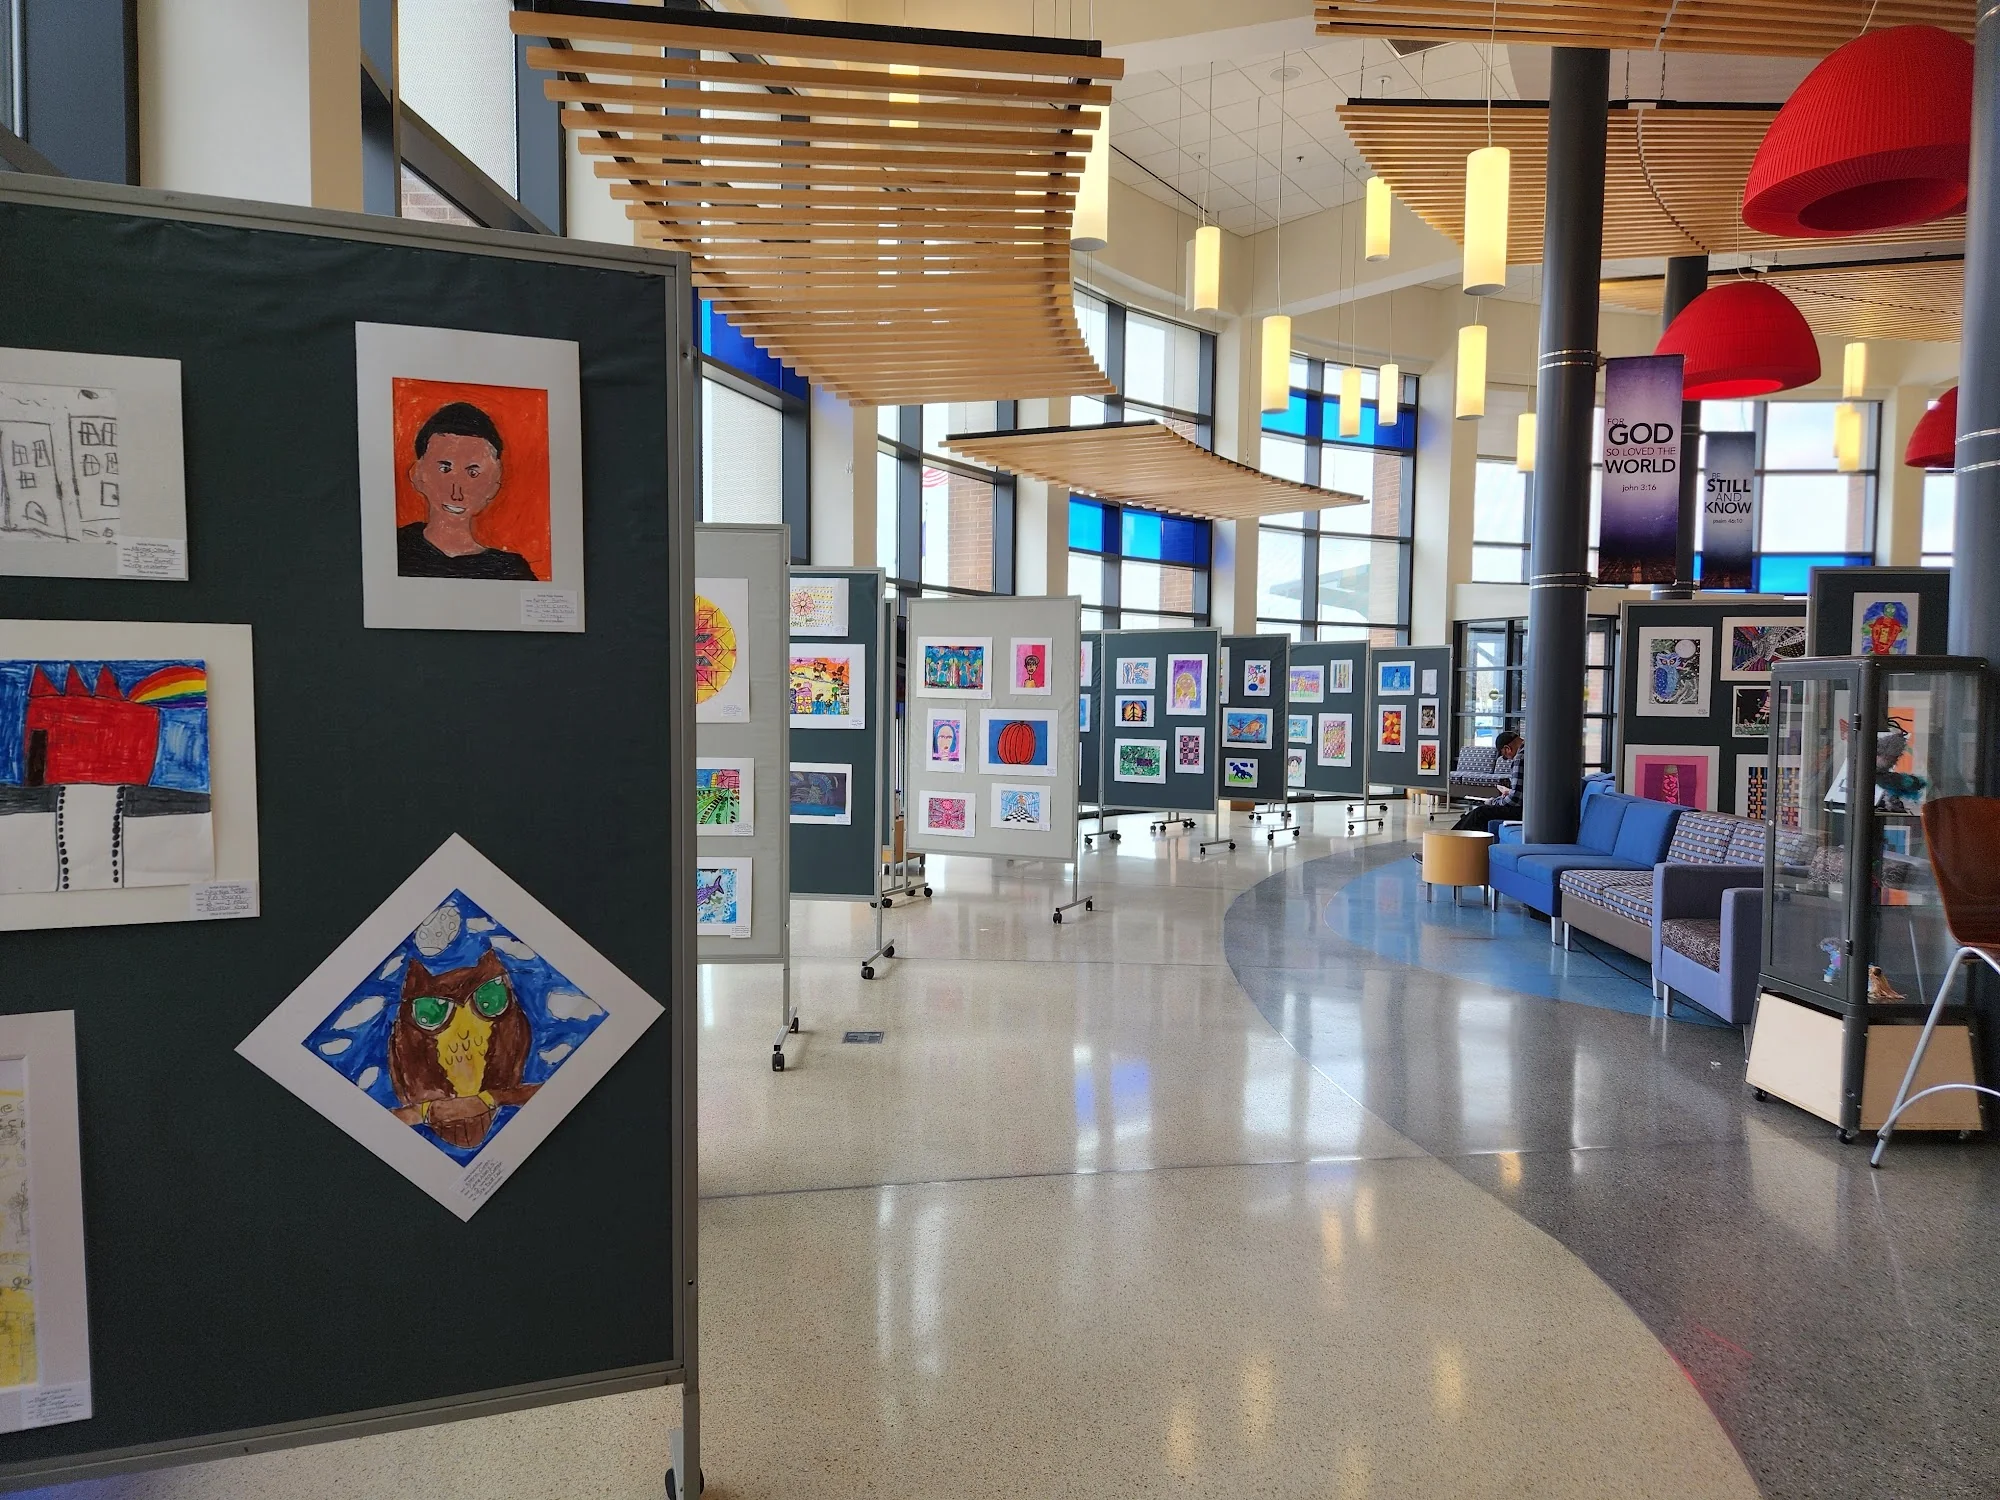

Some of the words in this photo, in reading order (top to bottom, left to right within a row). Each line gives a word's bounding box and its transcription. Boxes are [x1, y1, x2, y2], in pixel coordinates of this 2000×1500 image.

[1608, 422, 1674, 446] GOD
[1606, 448, 1620, 457] SO
[1622, 447, 1655, 457] LOVED
[1657, 446, 1677, 456] THE
[1605, 458, 1676, 474] WORLD
[1711, 472, 1721, 480] BE
[1622, 484, 1639, 493] john
[1640, 483, 1657, 491] 3:16
[1706, 479, 1751, 493] STILL
[1715, 492, 1742, 502] AND
[1704, 501, 1752, 514] KNOW
